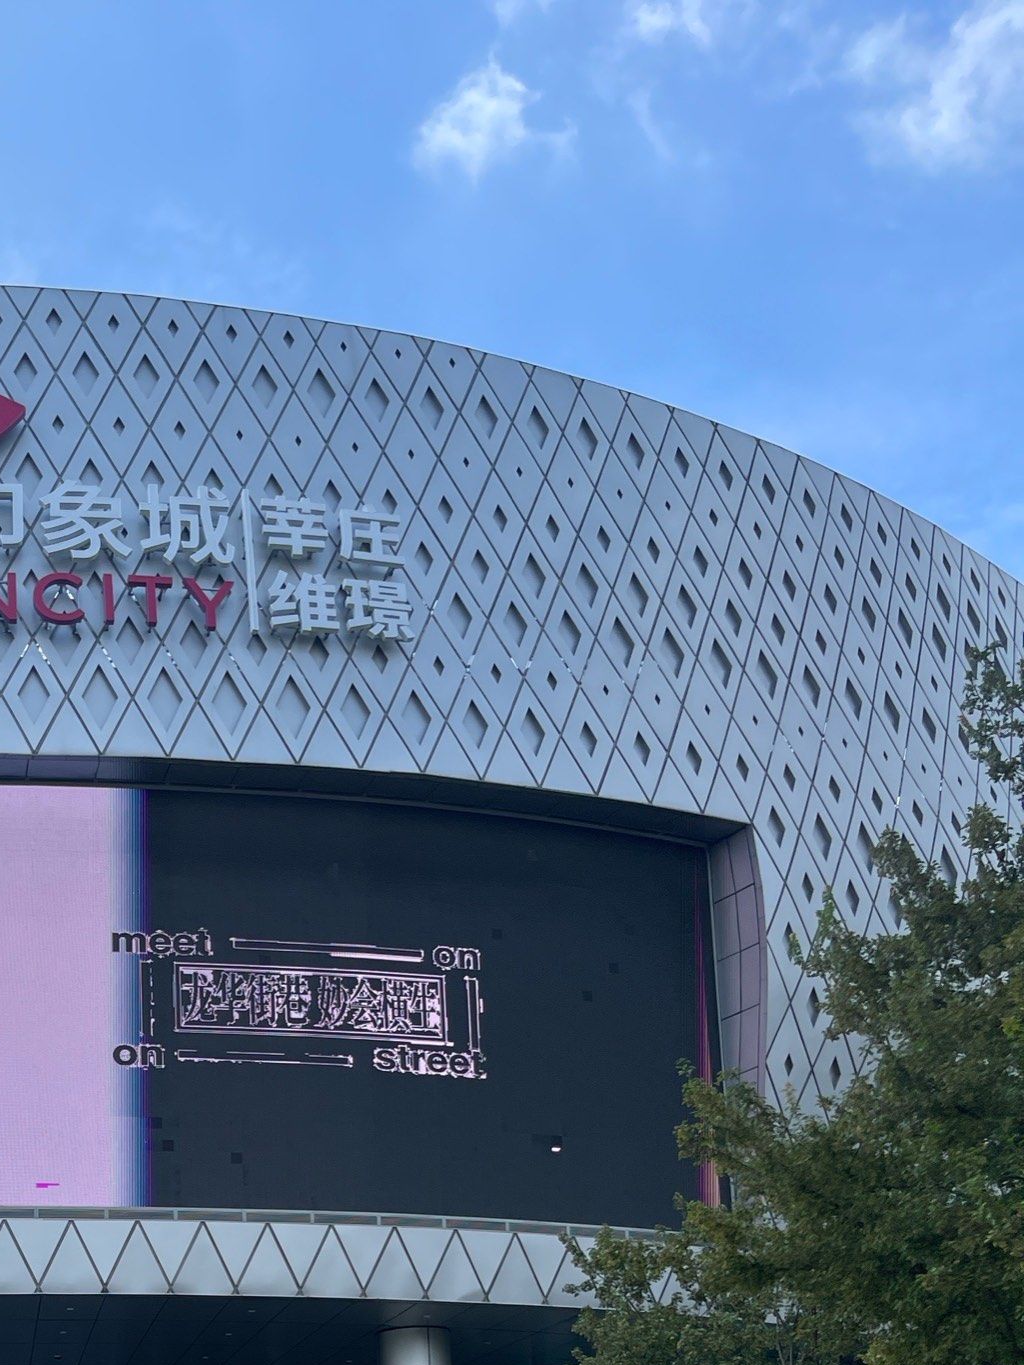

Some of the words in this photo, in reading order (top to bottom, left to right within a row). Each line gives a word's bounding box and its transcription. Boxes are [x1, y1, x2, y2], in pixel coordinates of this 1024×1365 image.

[260, 495, 406, 571] 莘庄
[268, 570, 416, 642] 维璟
[112, 928, 213, 957] meet
[433, 945, 480, 970] on
[314, 975, 442, 1035] 妙会横生
[112, 1044, 164, 1068] on
[373, 1045, 487, 1079] street
